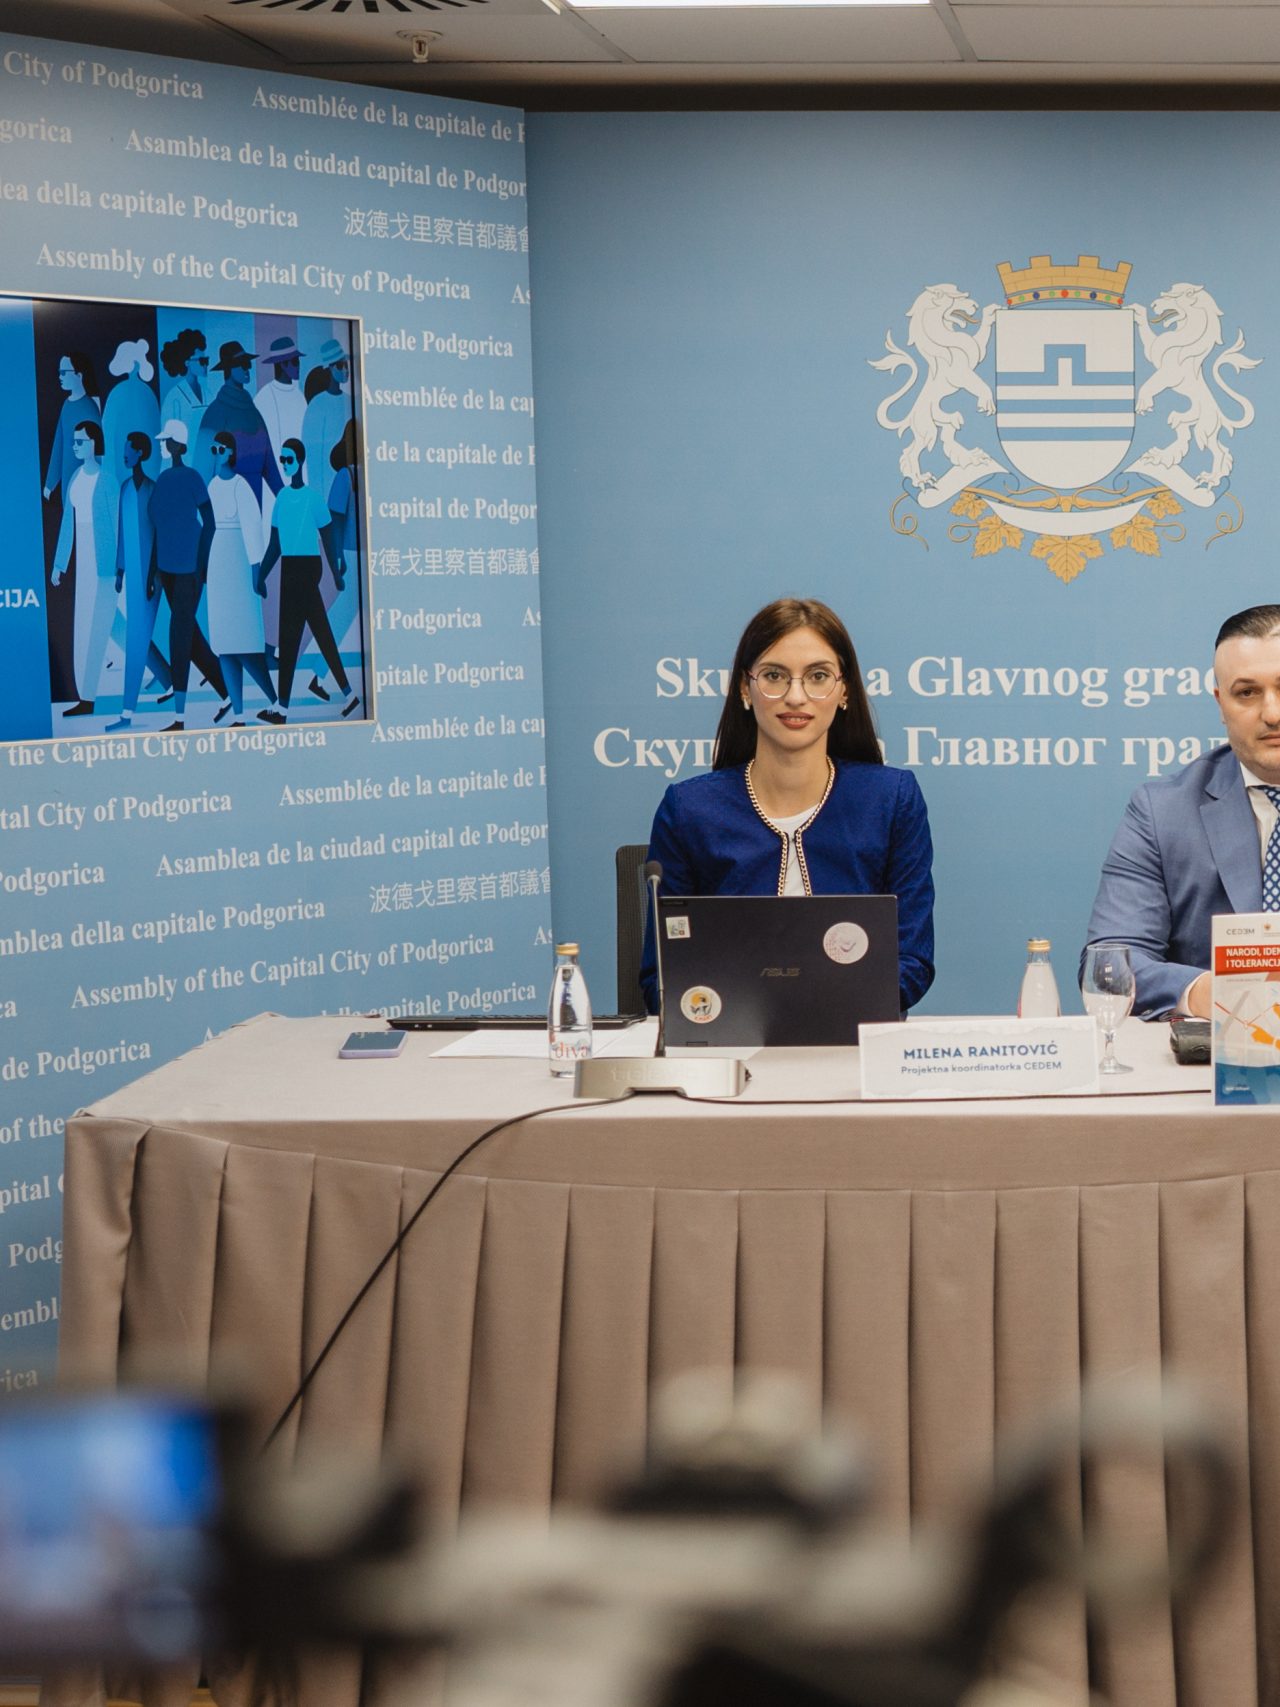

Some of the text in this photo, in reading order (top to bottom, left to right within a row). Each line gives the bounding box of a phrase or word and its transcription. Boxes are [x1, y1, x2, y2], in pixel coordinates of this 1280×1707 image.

[4, 51, 203, 99] City of Podgorica
[252, 86, 512, 141] Assemblée de la capitale de
[125, 129, 457, 188] Asamblea de la ciudad capital de
[37, 181, 298, 228] della capitale Podgorica
[37, 243, 470, 301] Assembly of the Capital City of Podgorica
[908, 656, 1108, 707] Glavnog
[903, 727, 1107, 767] Главног
[37, 791, 232, 830] City of Podgorica
[280, 768, 533, 806] Assemblée de la capitale de
[156, 826, 480, 876] Asamblea de la ciudad capital de
[71, 899, 325, 947] della capitale Podgorica
[71, 934, 494, 1008] Assembly of the Capital City of Podgorica
[1226, 960, 1229, 968] I
[2, 1040, 151, 1080] de Podgorica
[901, 1061, 1062, 1077] Projektna koordinatorka CEDEM
[904, 1040, 1059, 1060] MILENA RANITOVIĆ
